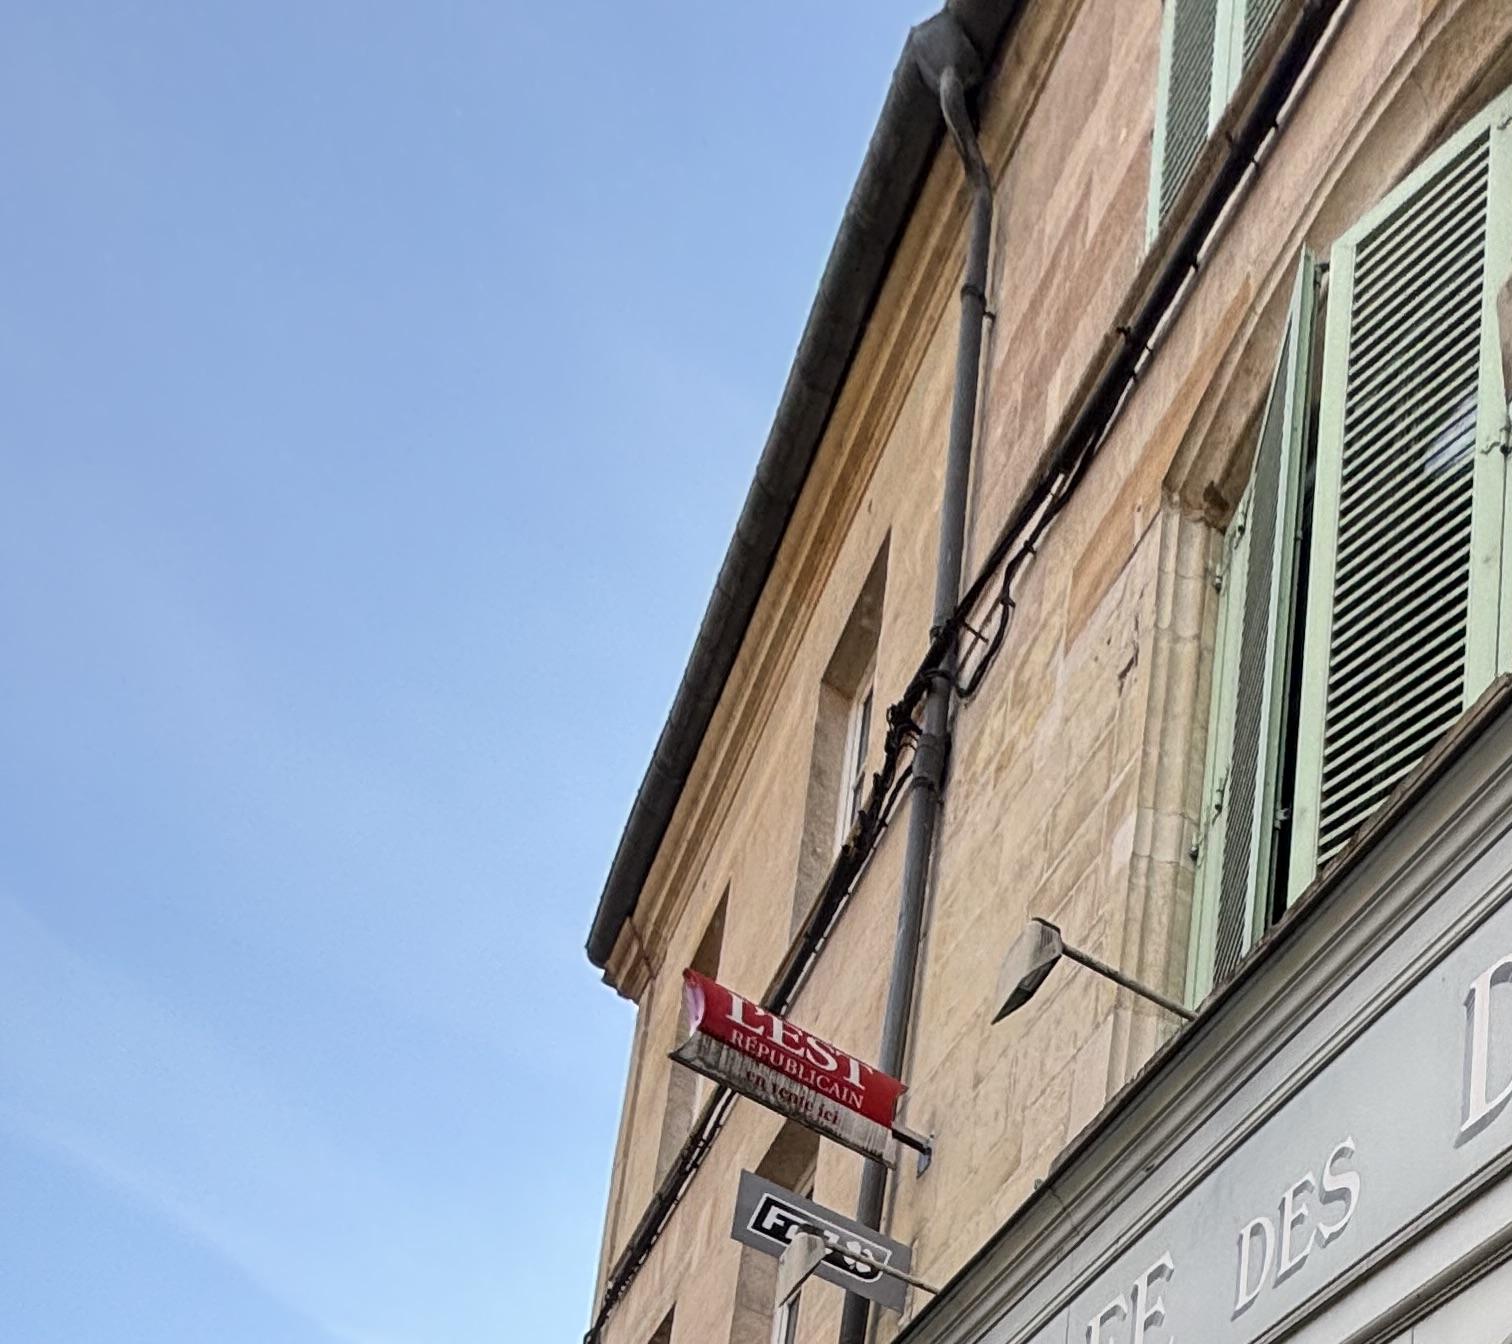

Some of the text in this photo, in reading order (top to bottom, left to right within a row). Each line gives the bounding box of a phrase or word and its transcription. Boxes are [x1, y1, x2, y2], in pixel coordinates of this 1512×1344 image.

[726, 990, 874, 1091] L'EST
[730, 1029, 865, 1110] RÉPUBLICAIN
[817, 1101, 839, 1126] ici
[1230, 1136, 1363, 1321] DES
